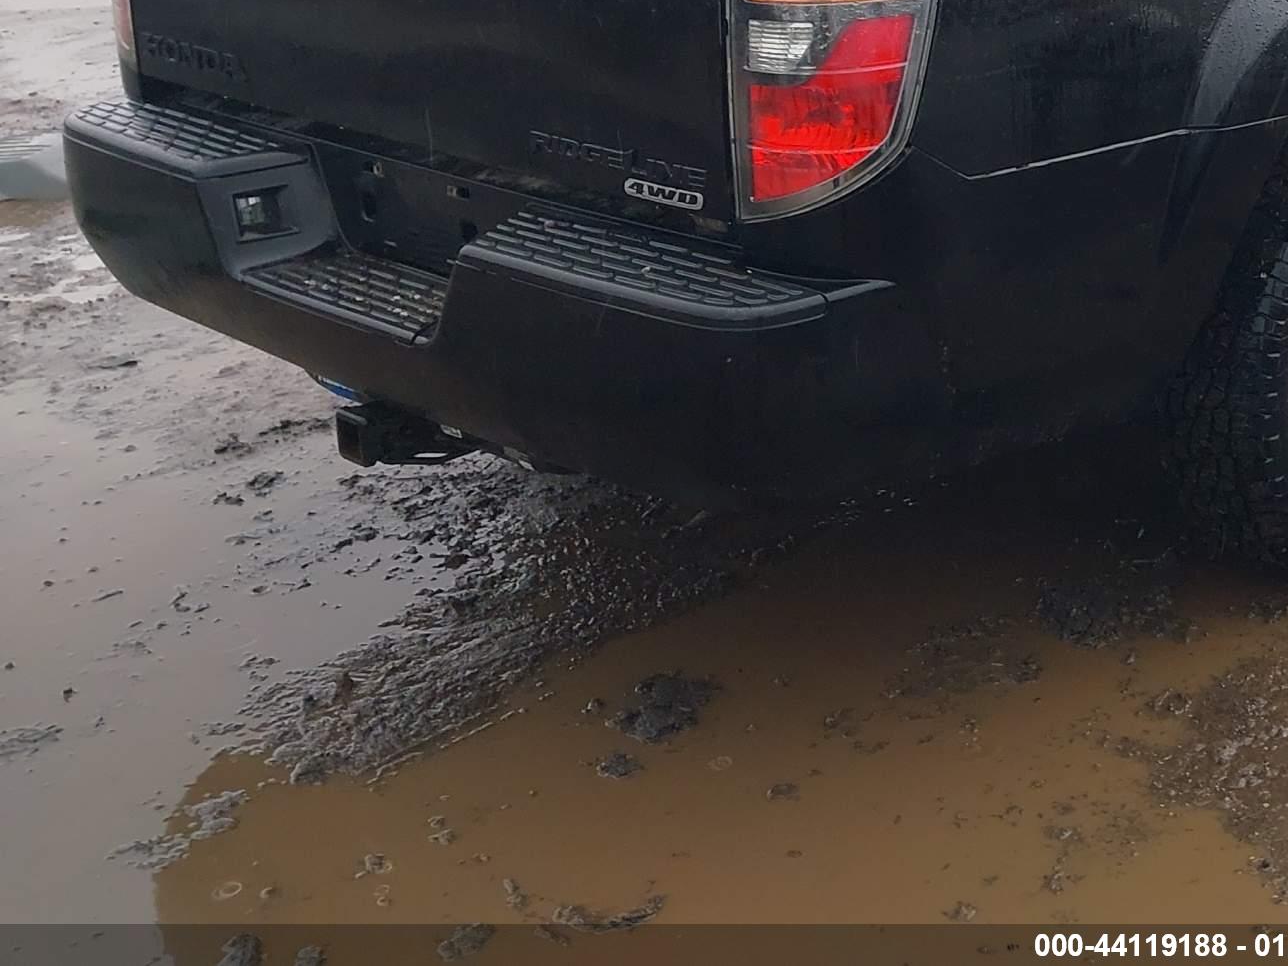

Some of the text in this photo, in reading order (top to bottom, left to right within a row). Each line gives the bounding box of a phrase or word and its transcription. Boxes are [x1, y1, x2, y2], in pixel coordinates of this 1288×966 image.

[140, 31, 249, 84] HONDA
[529, 129, 708, 190] RIDGELINE
[627, 180, 699, 206] 4WD
